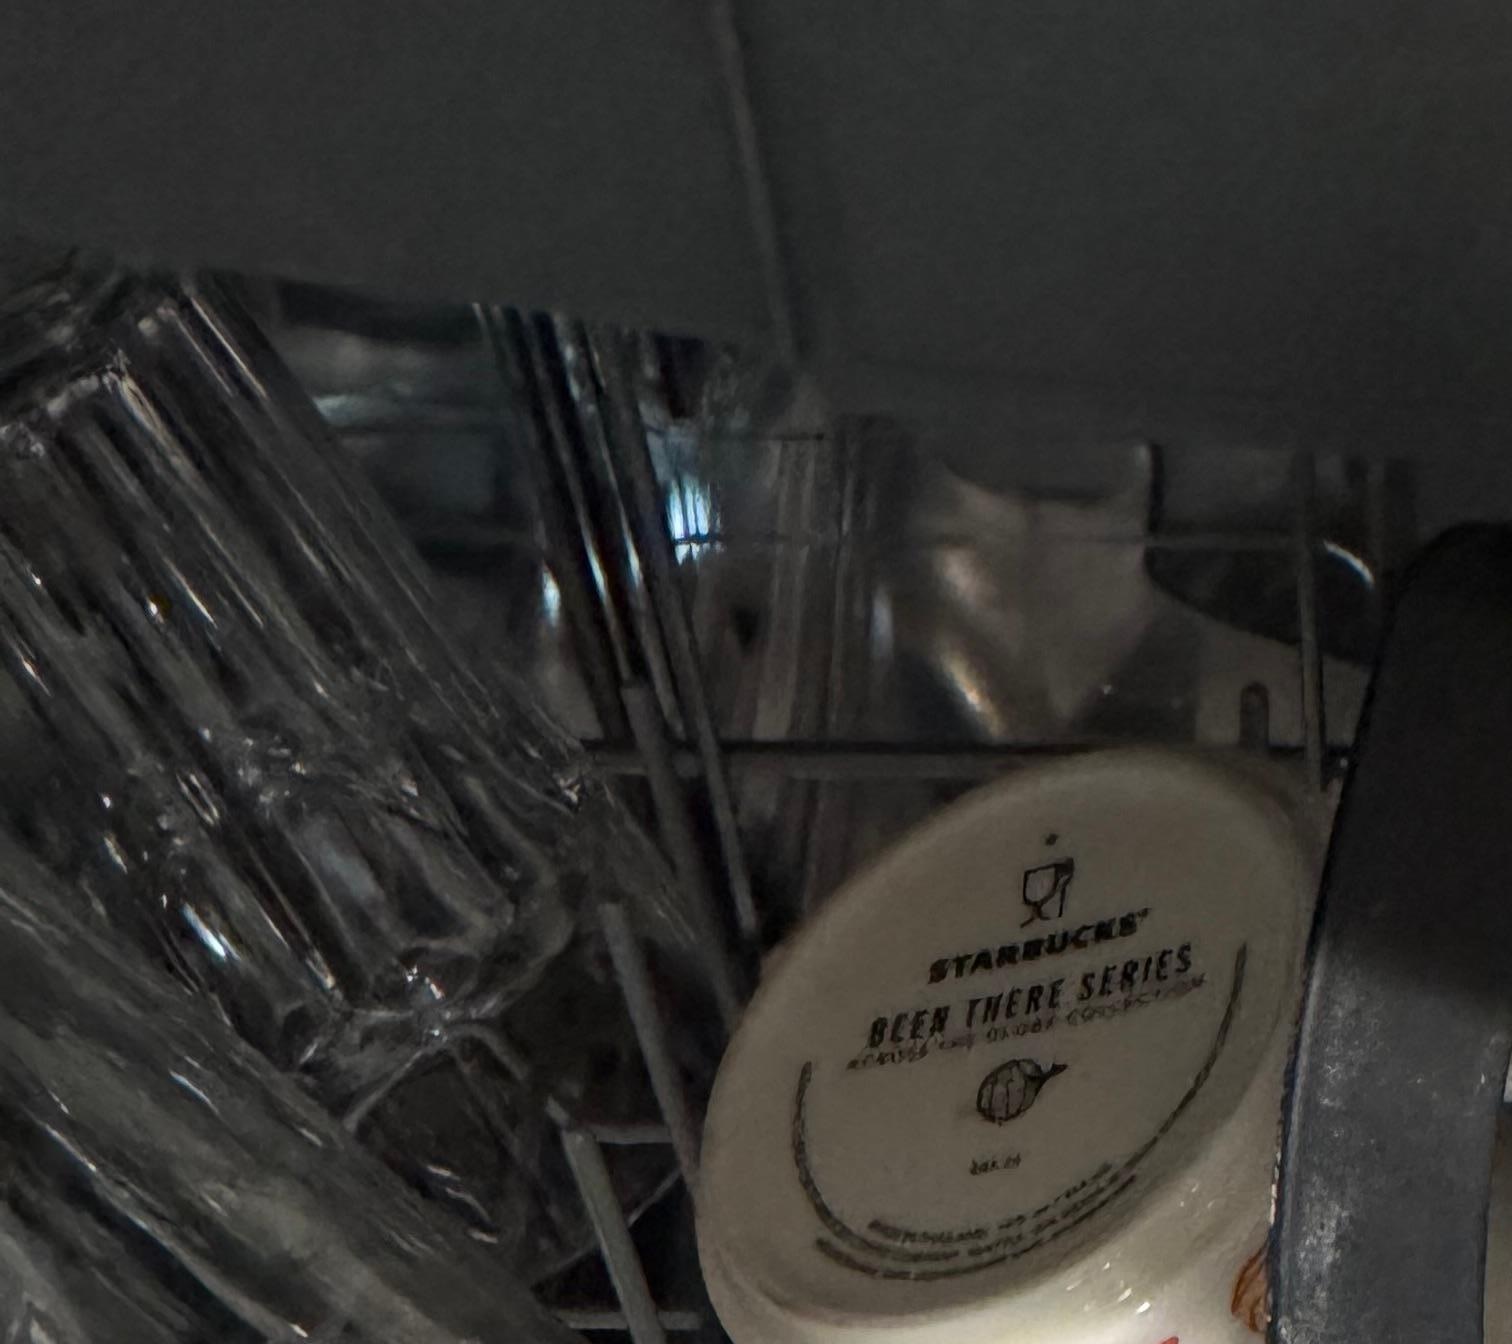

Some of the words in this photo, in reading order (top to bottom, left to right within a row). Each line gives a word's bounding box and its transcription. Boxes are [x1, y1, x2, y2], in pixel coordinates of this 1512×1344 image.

[868, 1005, 951, 1049] BEEN
[963, 977, 1065, 1028] THERE
[1077, 942, 1192, 1001] SERIES
